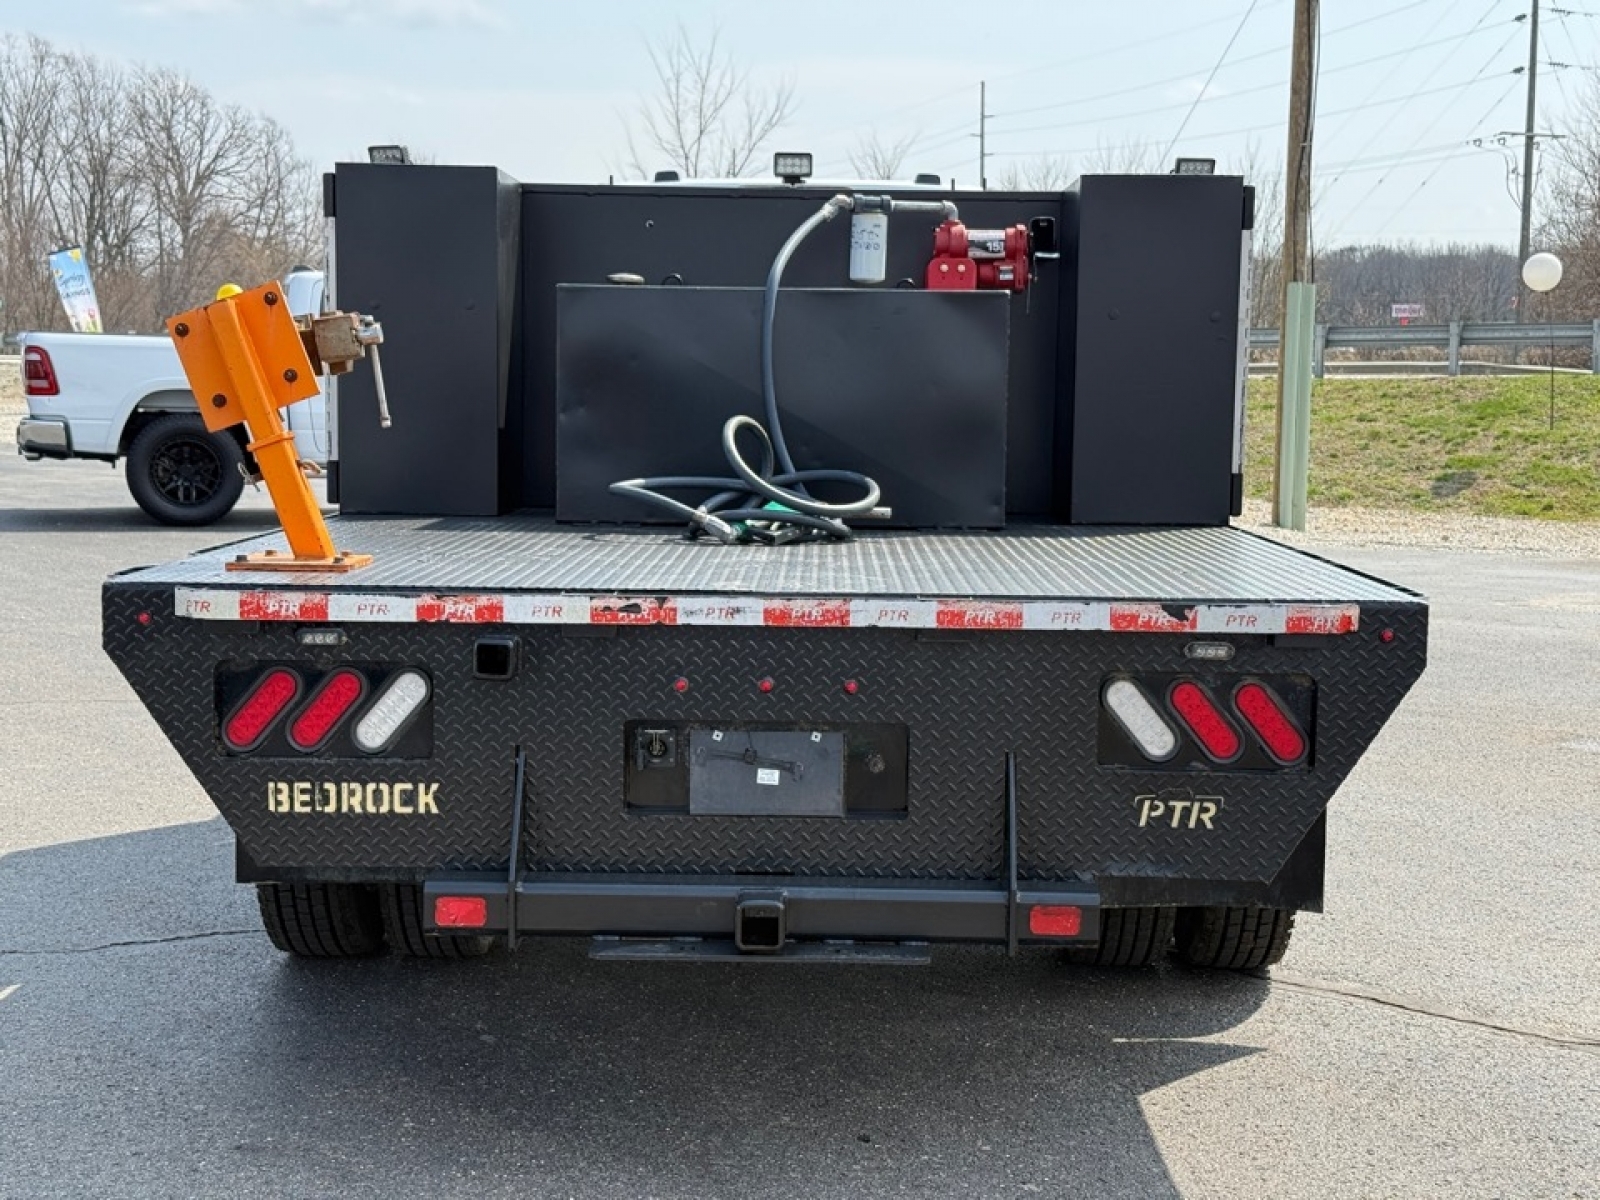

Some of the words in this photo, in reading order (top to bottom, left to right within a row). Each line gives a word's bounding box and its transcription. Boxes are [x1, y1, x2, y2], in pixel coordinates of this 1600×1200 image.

[269, 601, 299, 614] PTR
[532, 606, 562, 617] PTR
[705, 607, 735, 619] PTR
[878, 609, 909, 621] PTR
[965, 610, 996, 623] PTR
[1052, 611, 1081, 624] PTR
[1226, 615, 1258, 627] PTR
[267, 781, 440, 814] BEDROCK
[1139, 799, 1217, 829] PTR
